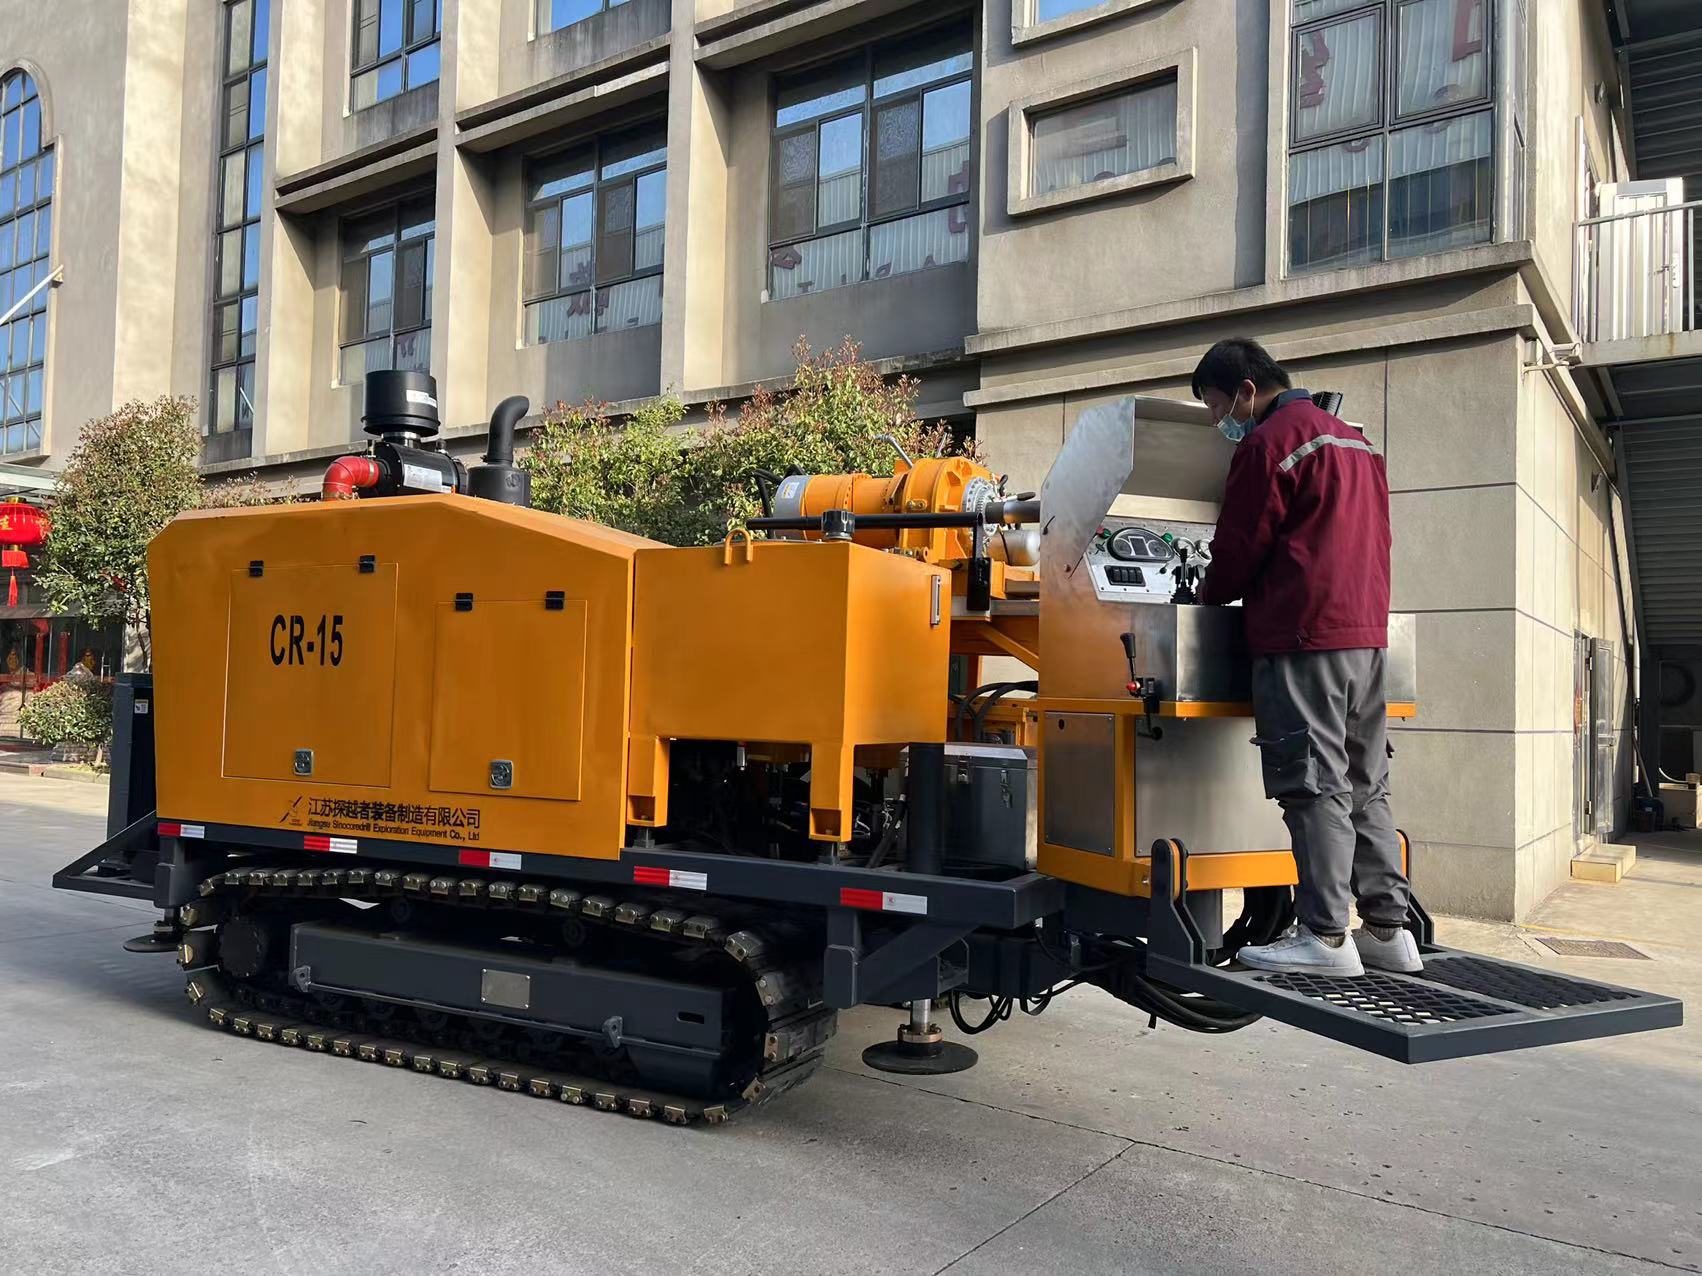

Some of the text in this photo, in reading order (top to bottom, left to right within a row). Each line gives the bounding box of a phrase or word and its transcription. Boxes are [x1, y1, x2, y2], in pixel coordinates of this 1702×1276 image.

[270, 614, 343, 667] CR-15
[308, 797, 480, 829] 江苏探越者装备制造有限公司
[307, 818, 330, 830] Jiangsu
[373, 823, 409, 836] Exploration
[411, 827, 447, 838] Equipment
[449, 830, 465, 841] Co.,
